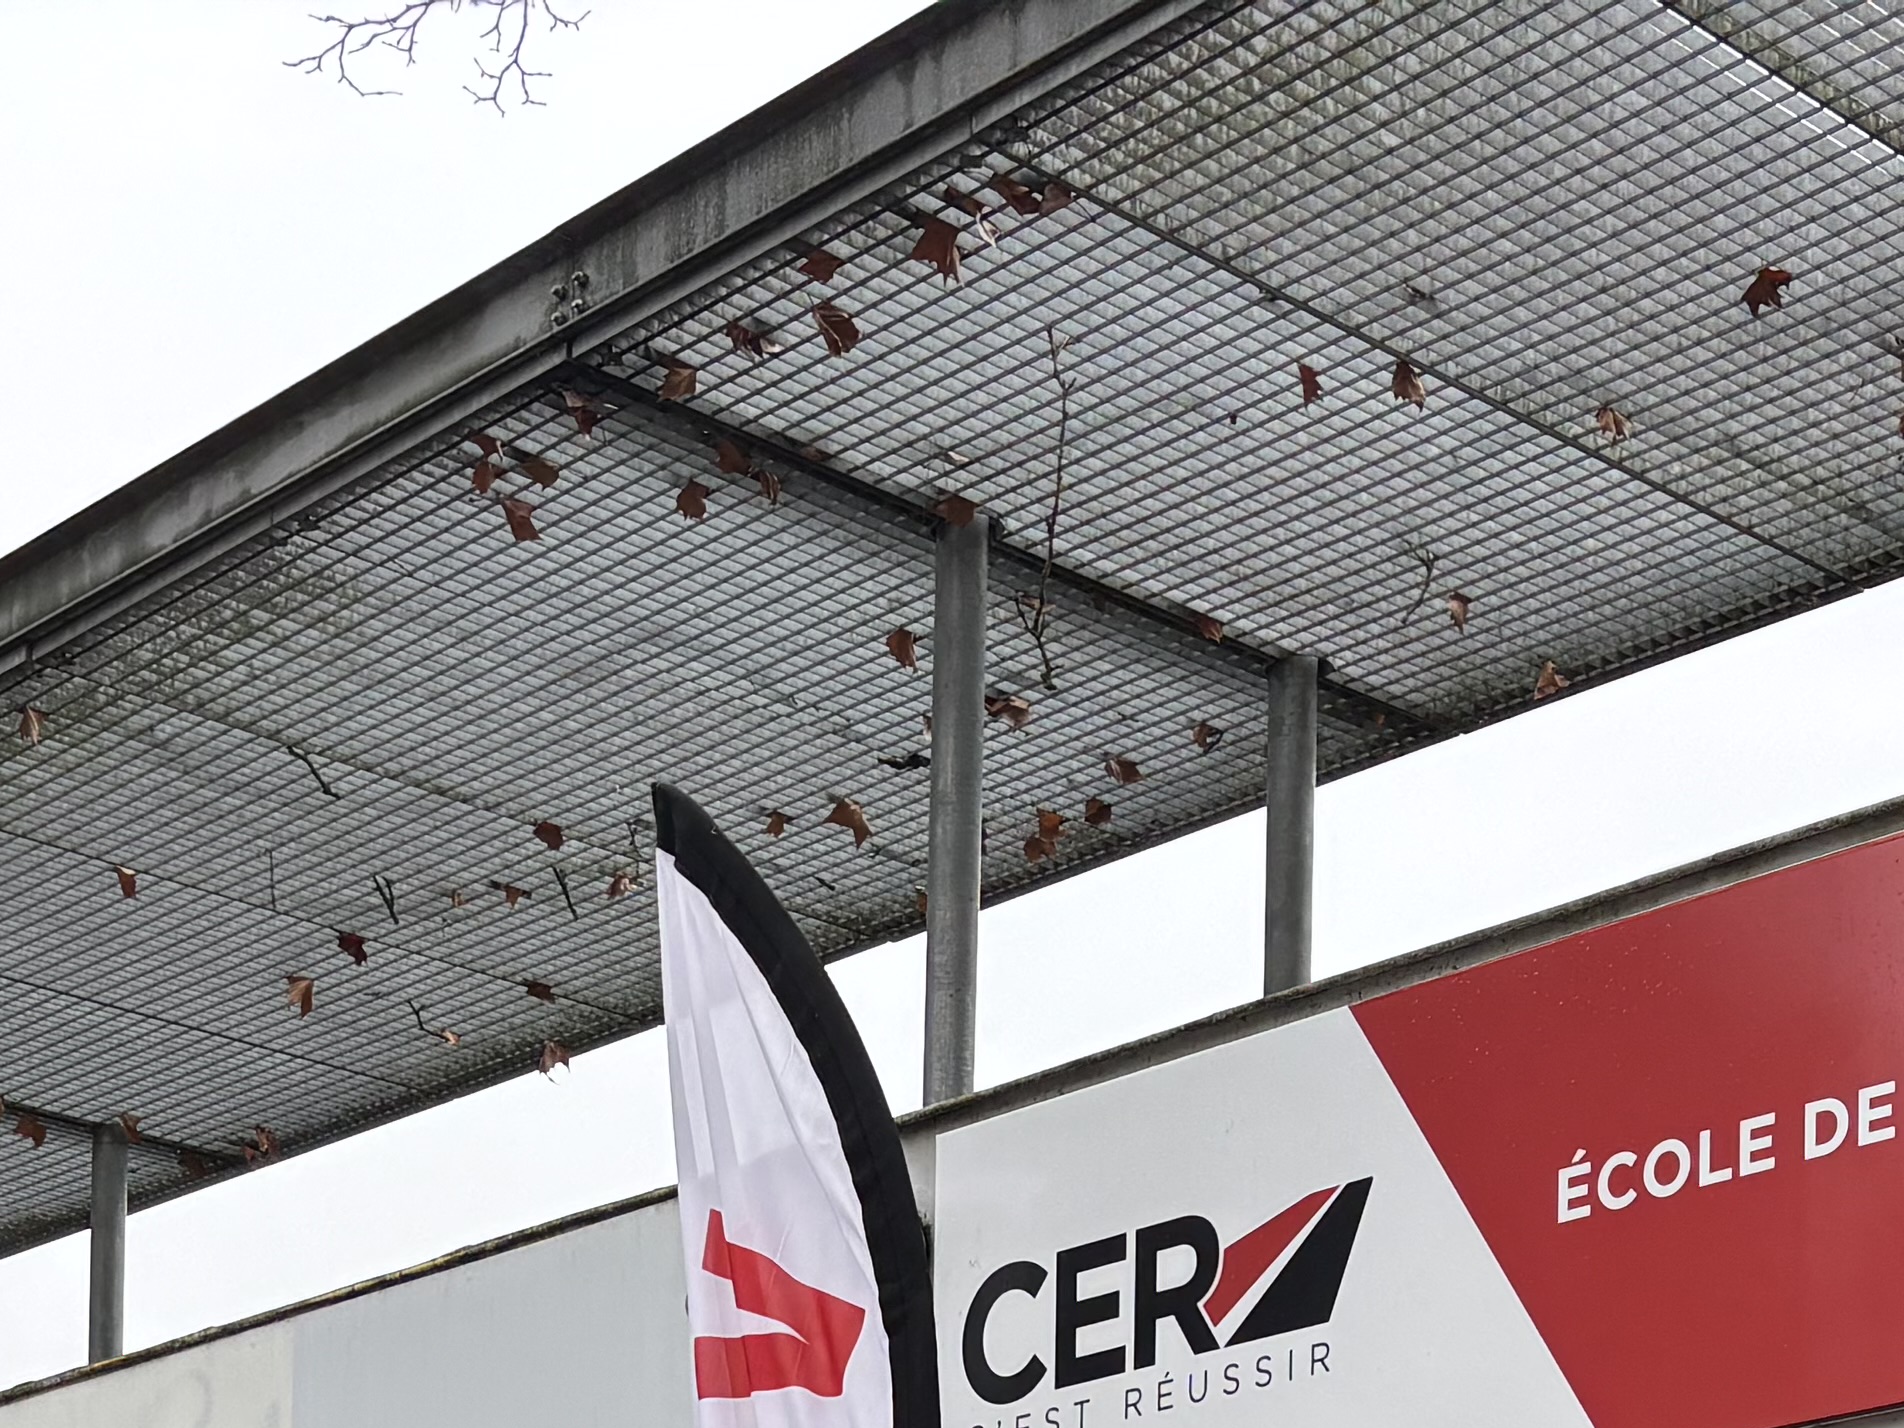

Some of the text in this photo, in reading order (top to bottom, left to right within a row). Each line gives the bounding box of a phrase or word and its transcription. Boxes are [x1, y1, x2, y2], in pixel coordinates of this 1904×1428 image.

[1557, 1111, 1777, 1224] ÉCOLE
[1803, 1080, 1896, 1161] DE
[962, 1215, 1220, 1406] CER
[1124, 1342, 1332, 1420] RÉUSSIR
